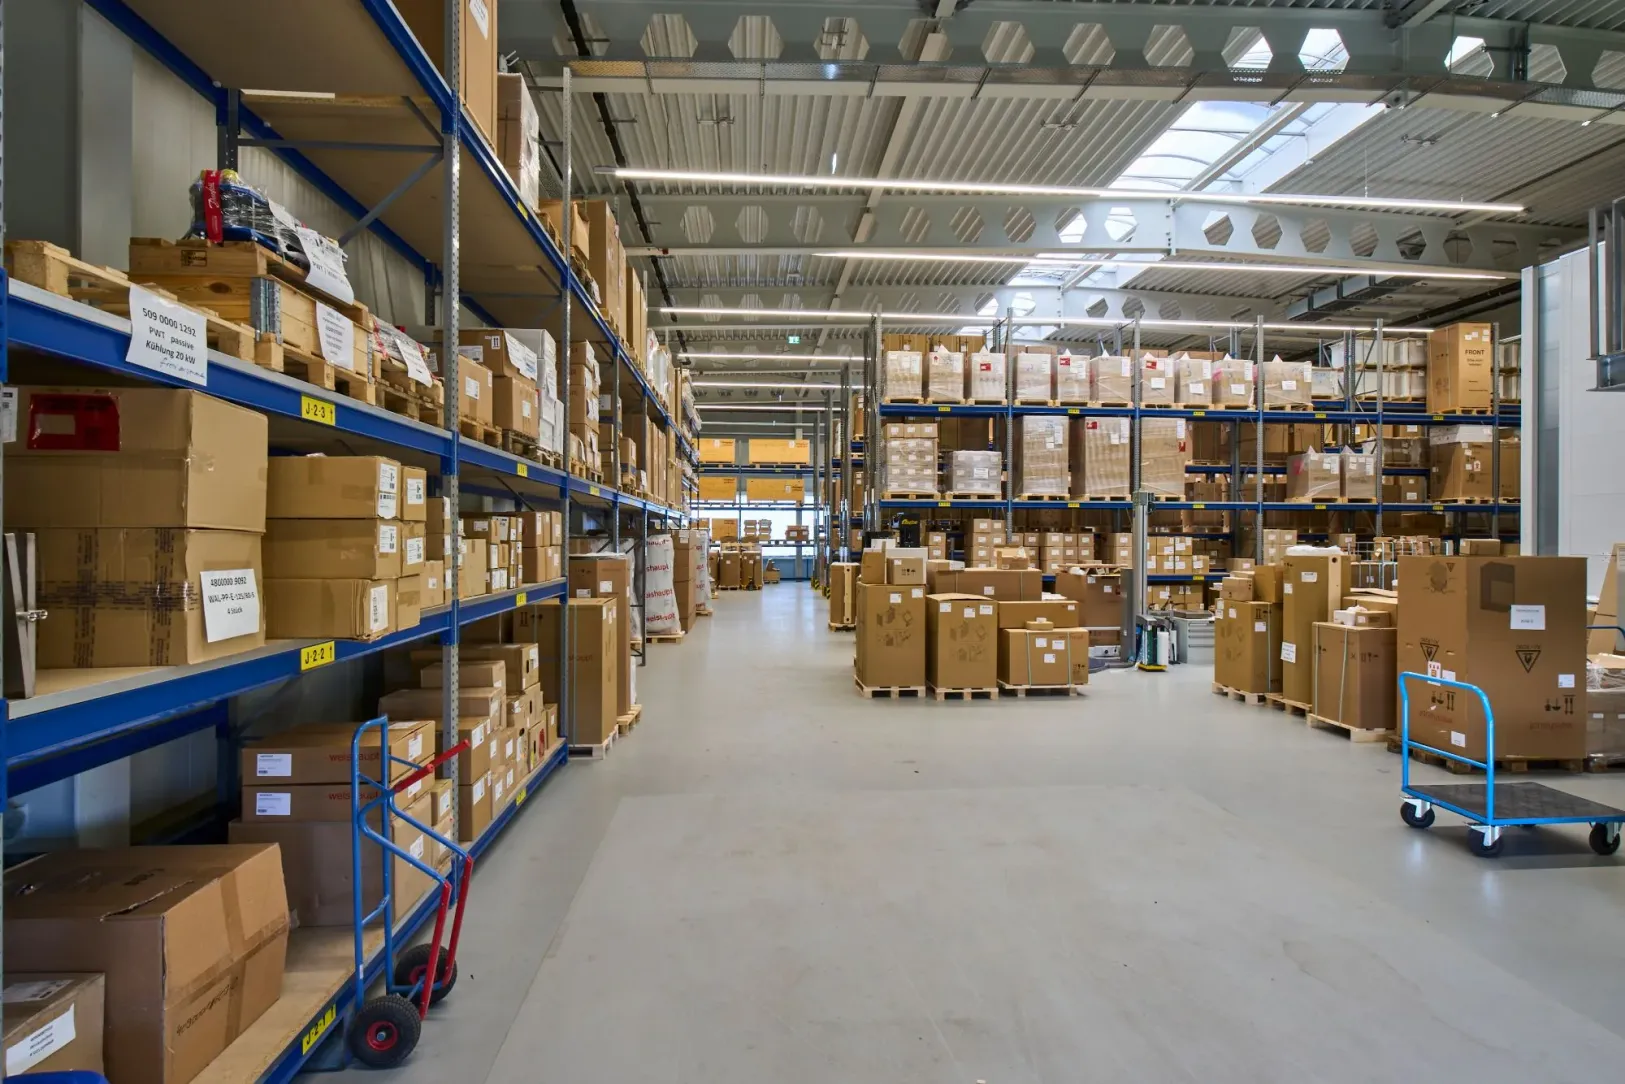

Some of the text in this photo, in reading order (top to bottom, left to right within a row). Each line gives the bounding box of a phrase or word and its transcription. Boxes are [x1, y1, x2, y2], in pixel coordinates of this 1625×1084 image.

[142, 307, 197, 338] 509 0000 1292
[149, 326, 194, 350] PWT passive
[145, 339, 196, 365] Kühlung 20 kW
[329, 752, 380, 762] weisaupt
